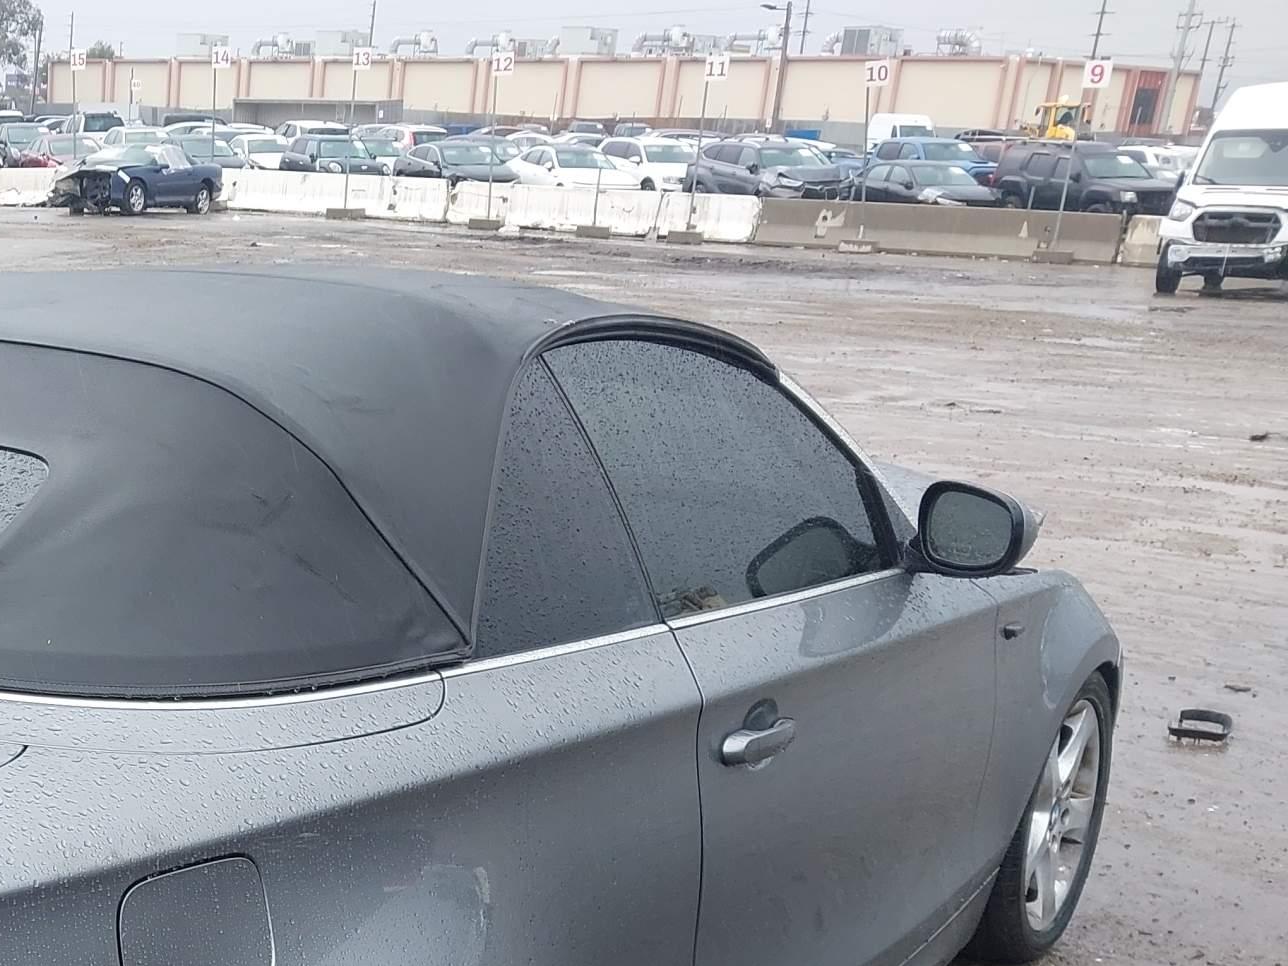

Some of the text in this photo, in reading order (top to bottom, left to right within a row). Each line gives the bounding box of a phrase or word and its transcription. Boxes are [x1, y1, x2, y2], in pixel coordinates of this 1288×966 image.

[71, 52, 85, 66] 15
[213, 50, 229, 64] 14
[354, 51, 371, 66] 13
[493, 56, 513, 72] 12
[706, 60, 727, 77] 11
[866, 65, 889, 82] 10
[1090, 64, 1105, 84] 9
